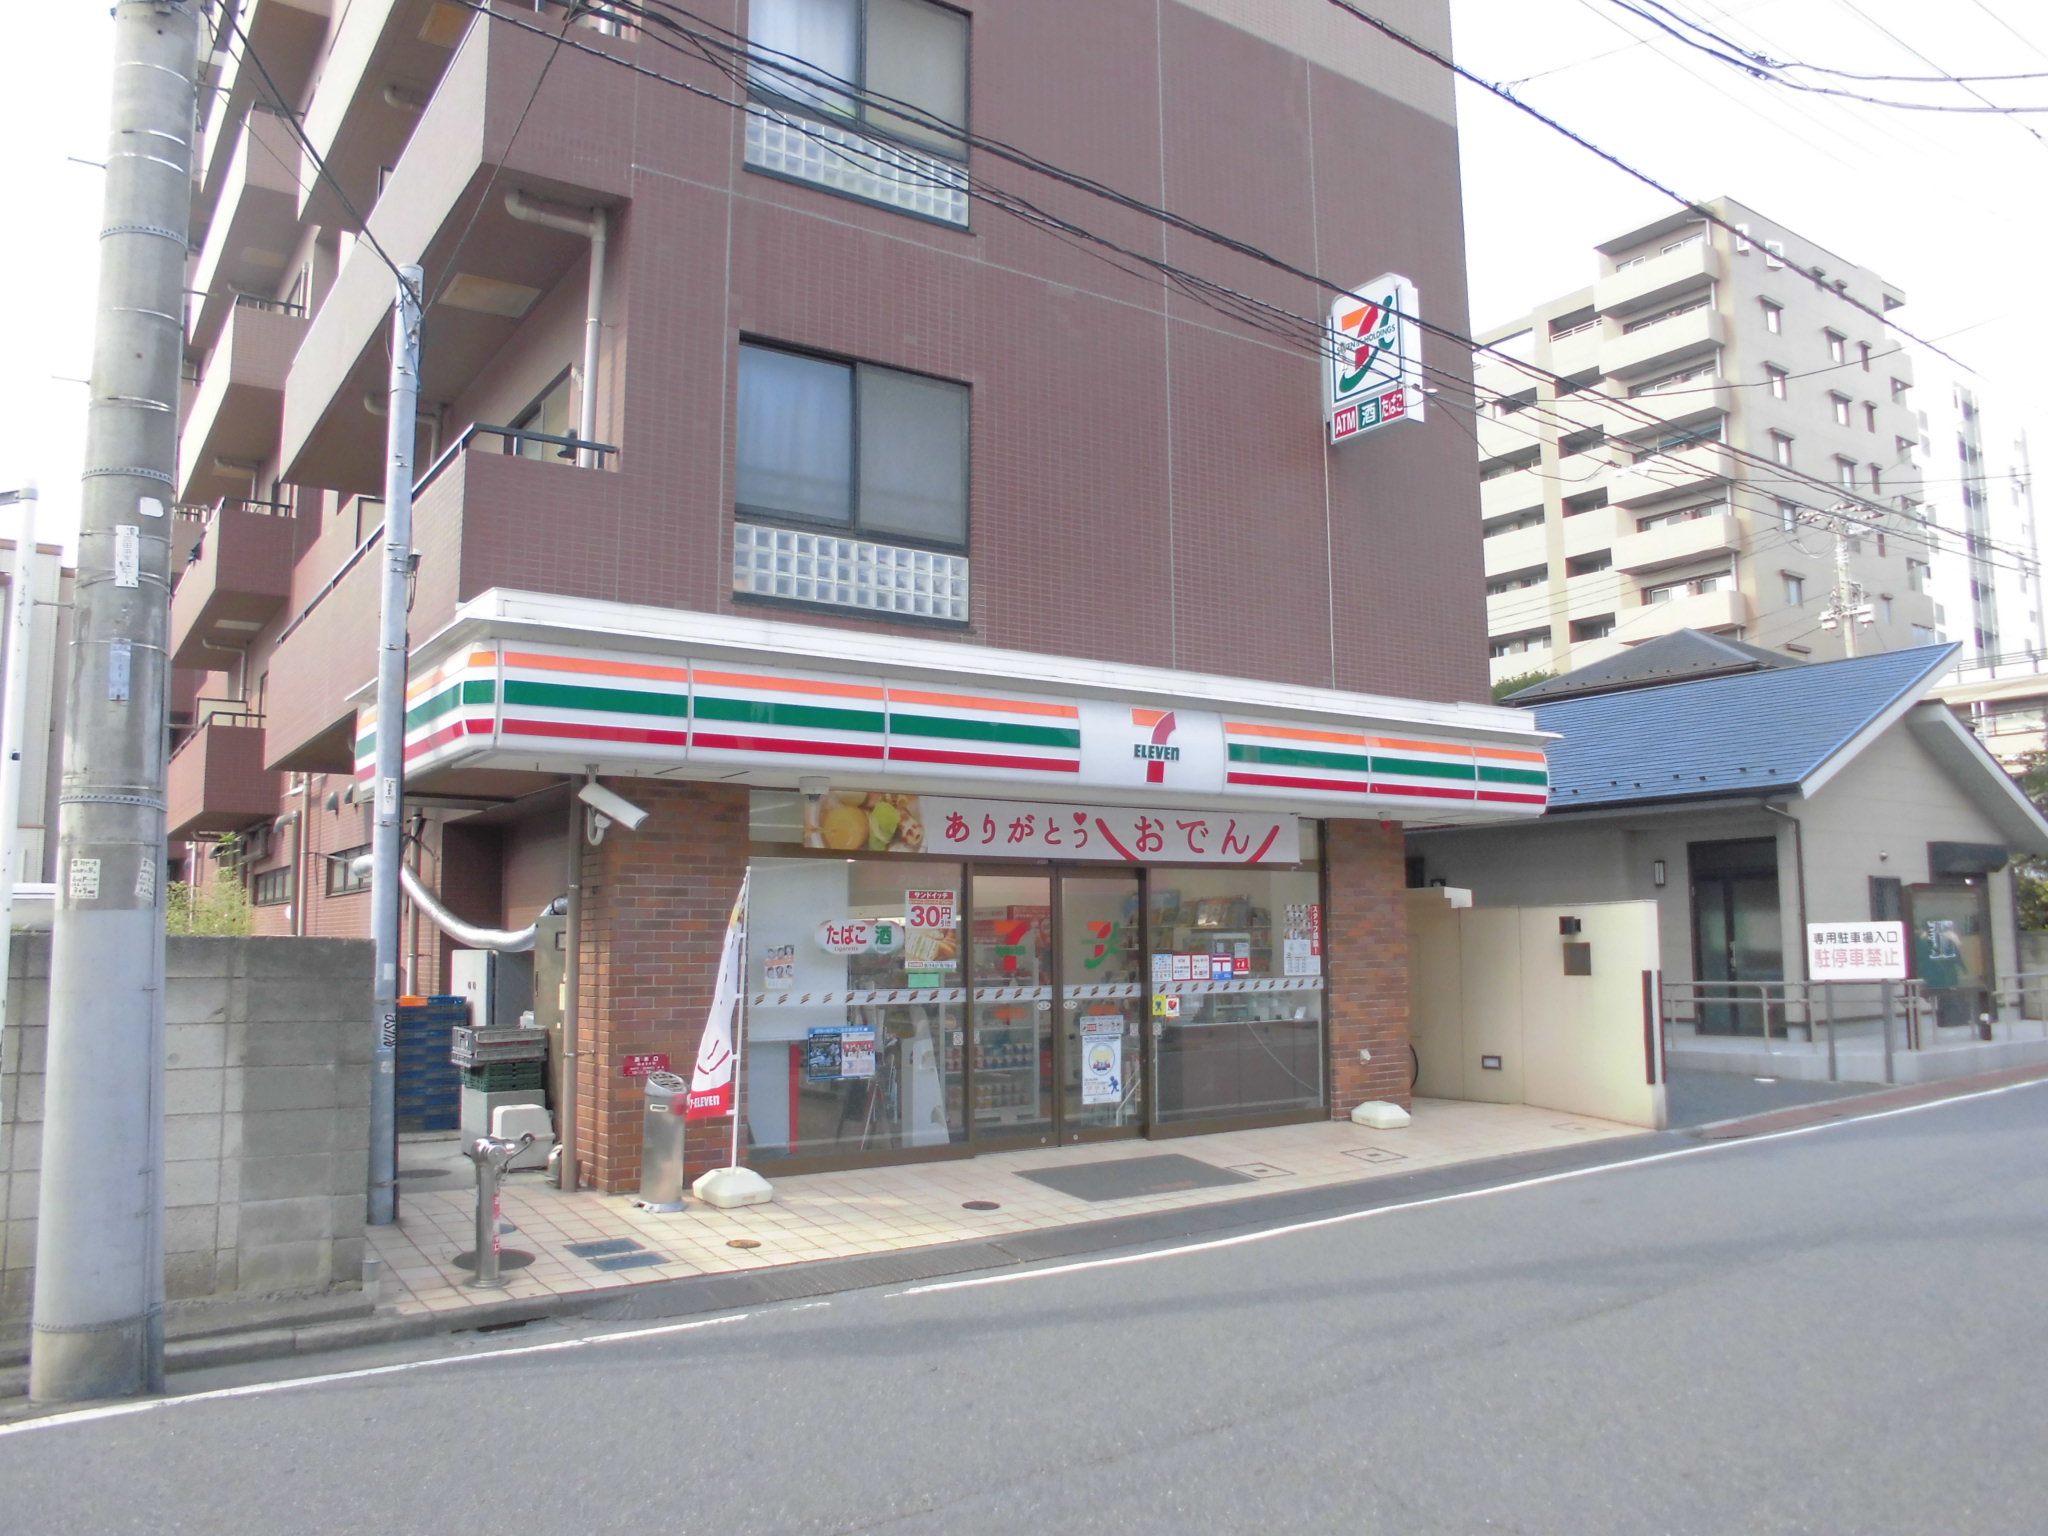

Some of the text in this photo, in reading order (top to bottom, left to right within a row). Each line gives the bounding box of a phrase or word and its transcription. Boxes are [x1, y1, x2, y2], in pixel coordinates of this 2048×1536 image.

[1361, 402, 1376, 426] 酒
[1381, 393, 1403, 417] たばこ
[1335, 410, 1356, 435] ATM
[945, 811, 1088, 849] ありがとう
[1134, 815, 1250, 856] おでん
[914, 891, 948, 899] サンドイッチ
[826, 925, 867, 944] たばこ
[875, 925, 892, 944] 酒
[1813, 931, 1897, 945] 専用駐車場入口
[1814, 947, 1900, 968] 駐停車禁止
